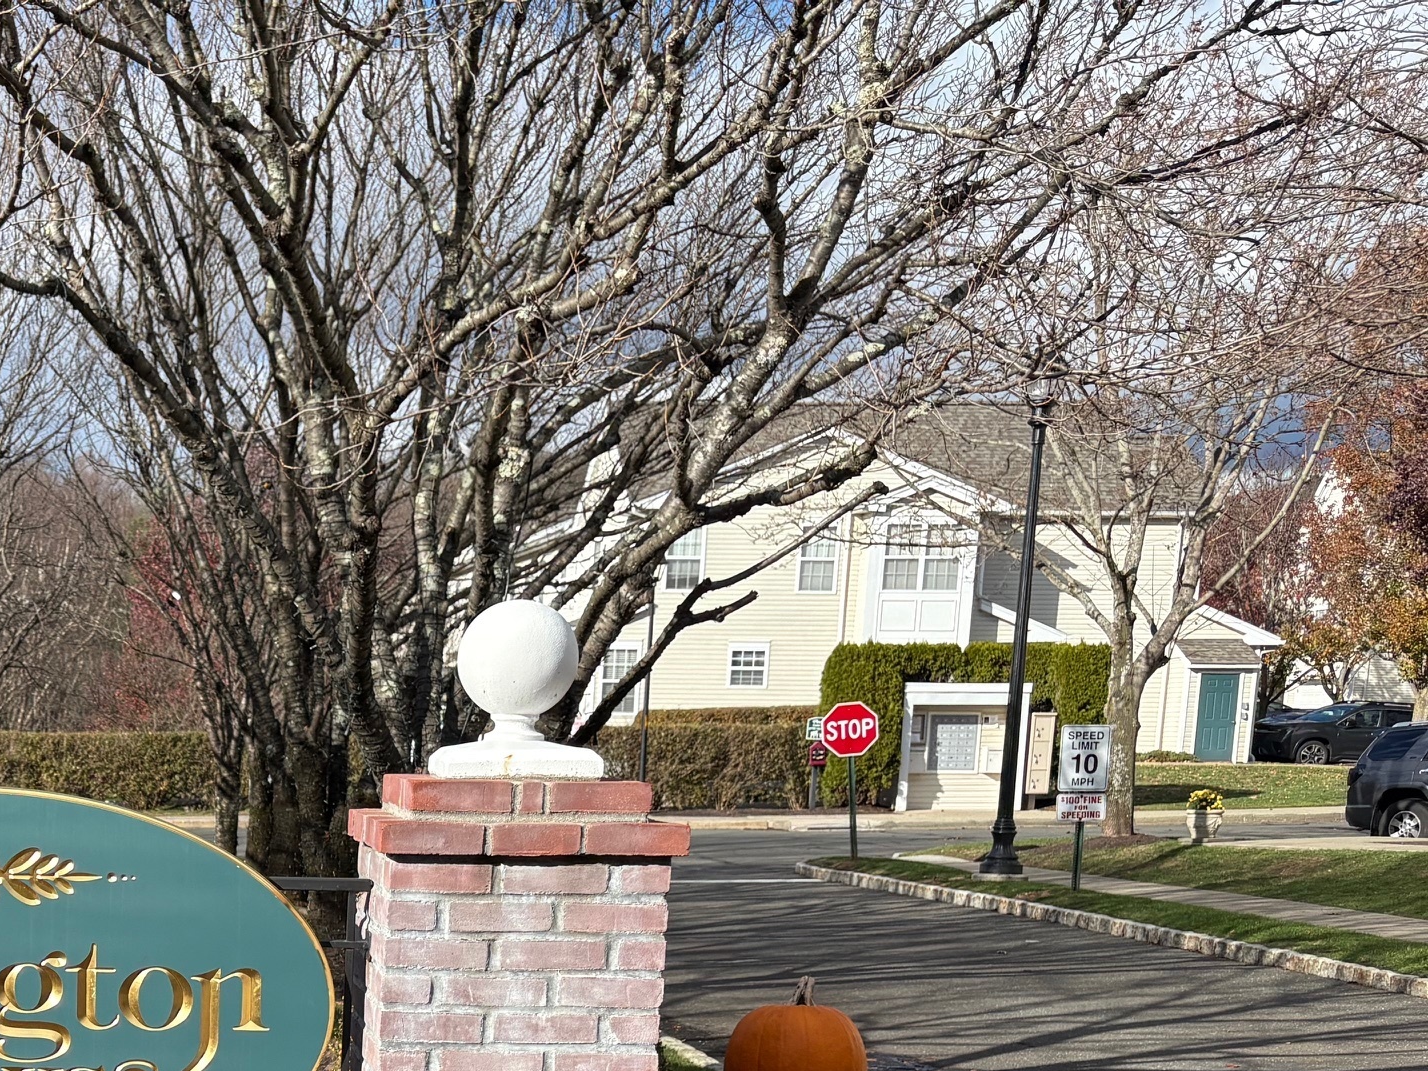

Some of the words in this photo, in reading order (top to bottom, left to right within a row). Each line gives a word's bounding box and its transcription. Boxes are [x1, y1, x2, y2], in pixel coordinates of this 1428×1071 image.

[826, 718, 874, 741] STOP
[1068, 731, 1104, 740] SPEED
[1071, 741, 1100, 750] LIMIT
[1071, 753, 1098, 774] 10
[1071, 777, 1094, 786] MPH
[1061, 796, 1080, 805] $100
[1083, 795, 1102, 804] FINE
[1061, 810, 1101, 819] SPEEDING
